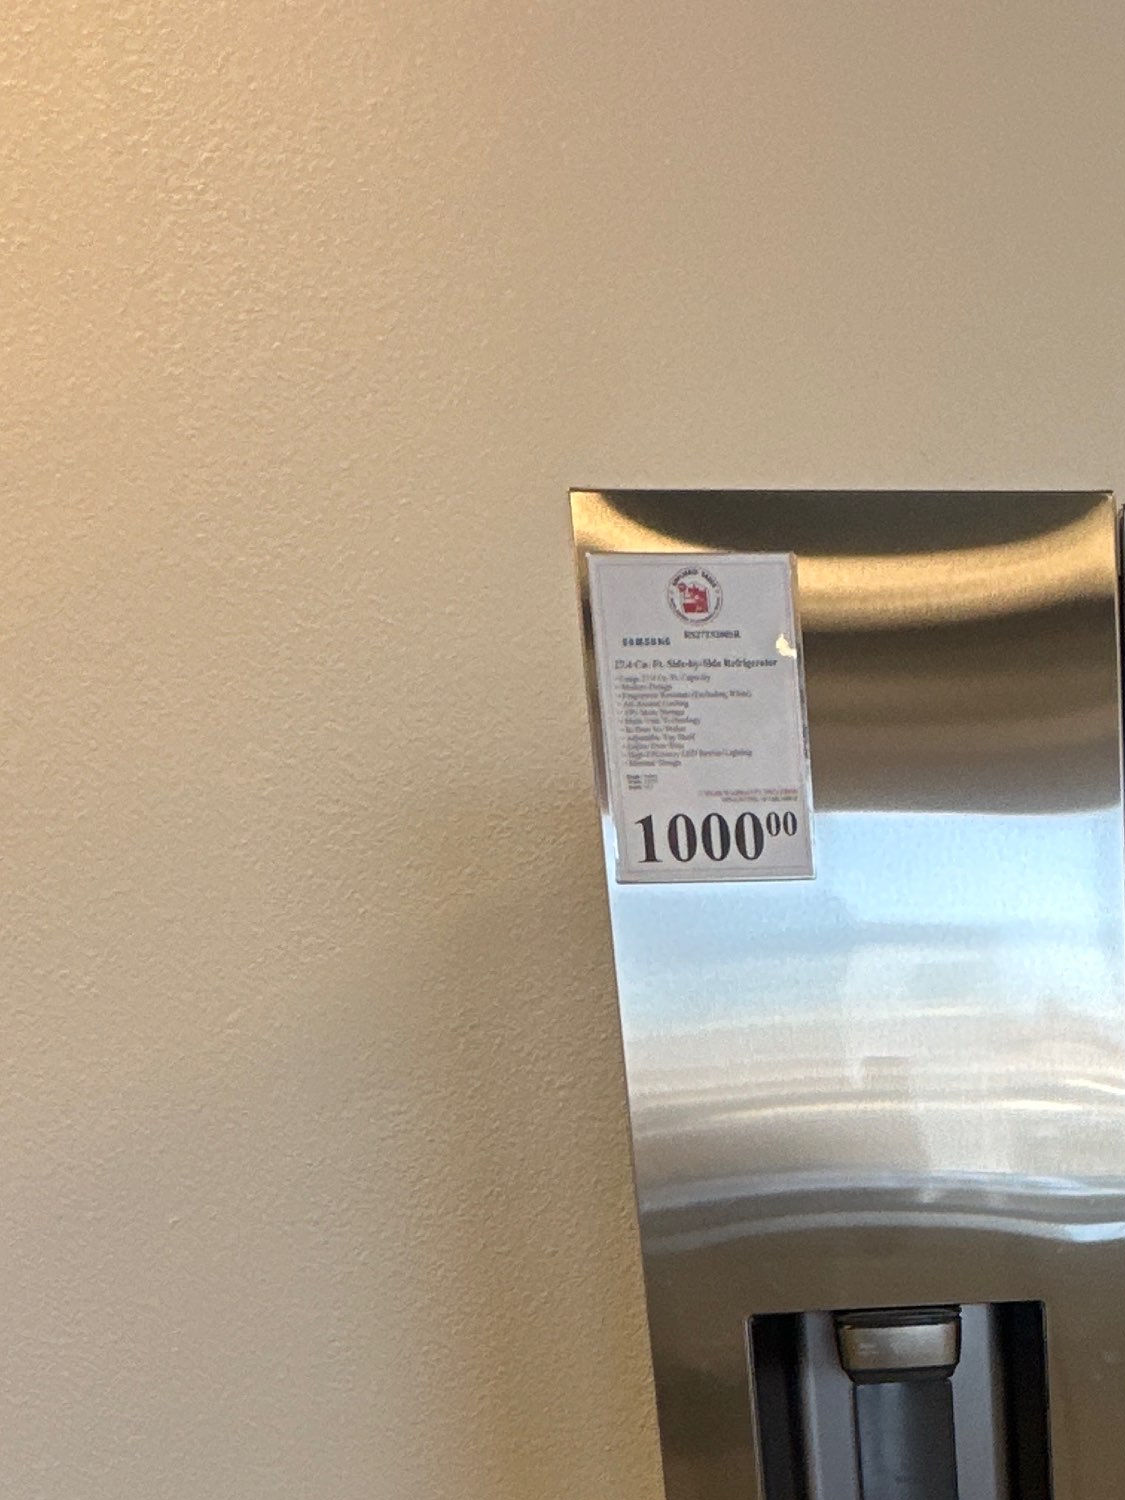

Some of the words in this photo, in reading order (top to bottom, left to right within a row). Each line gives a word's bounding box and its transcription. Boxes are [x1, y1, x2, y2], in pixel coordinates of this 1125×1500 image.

[623, 637, 671, 646] SAMSUNG
[723, 658, 777, 669] Refrigerator
[634, 812, 765, 863] 1000
